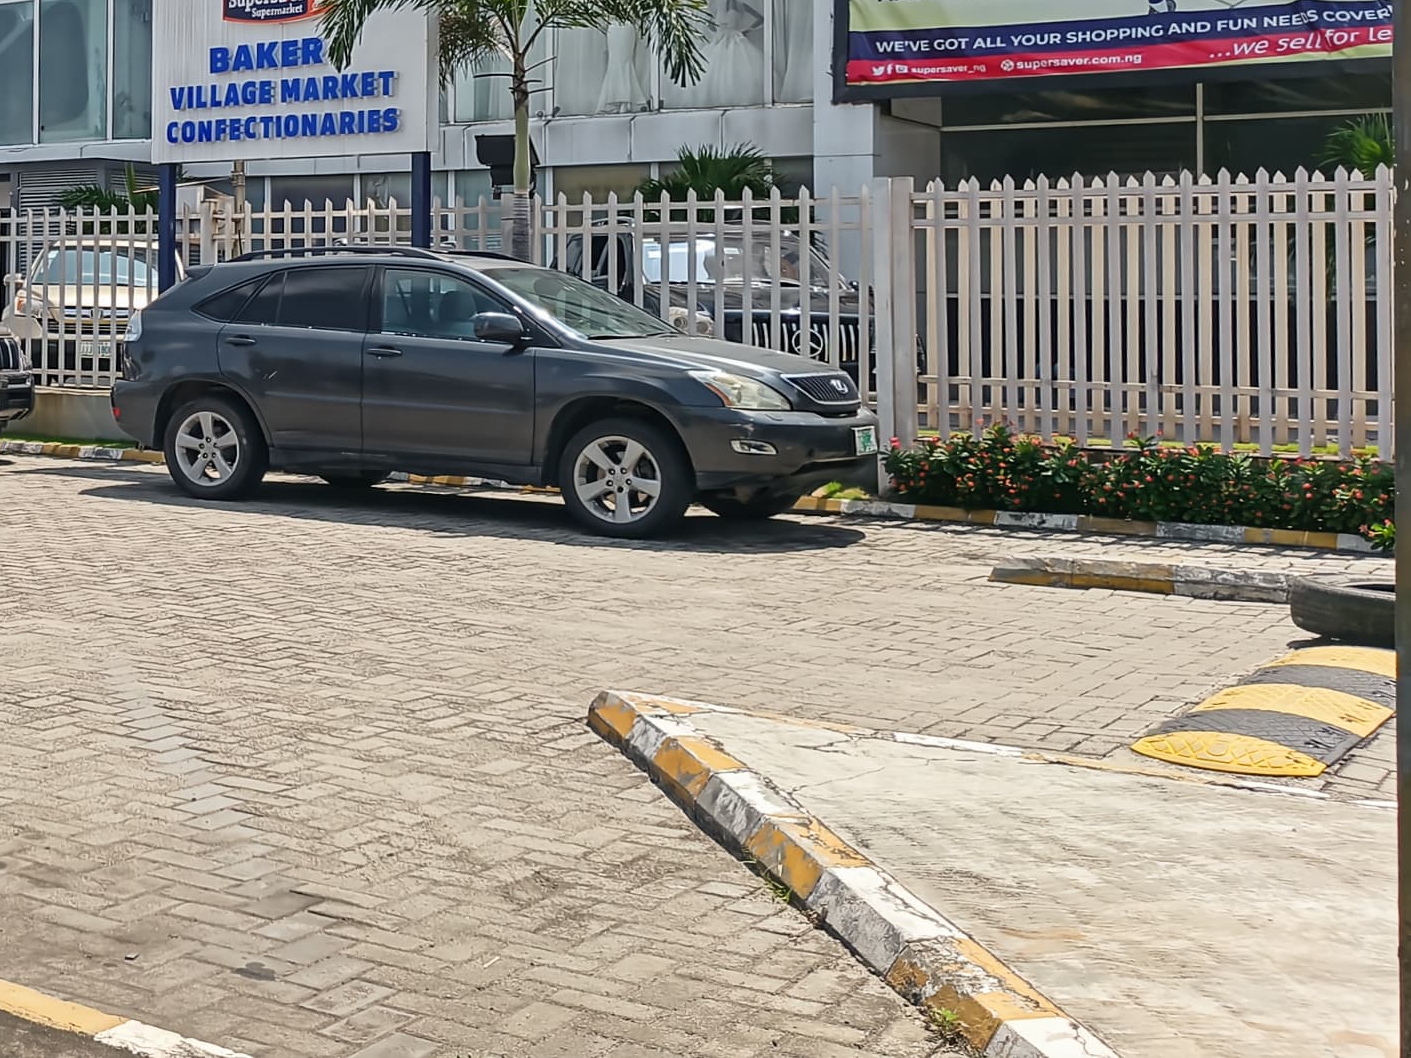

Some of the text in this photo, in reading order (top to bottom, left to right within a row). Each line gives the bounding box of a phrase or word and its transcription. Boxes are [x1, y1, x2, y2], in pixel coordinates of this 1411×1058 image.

[251, 4, 303, 19] Supermarket
[876, 40, 929, 53] WE'VE
[933, 38, 969, 51] GOT
[973, 37, 1006, 49] ALL
[1011, 33, 1061, 47] YOUR
[1066, 25, 1163, 44] SHOPPING
[1168, 21, 1211, 36] AND
[1216, 18, 1257, 32] FUN
[1277, 31, 1321, 52] sell
[1326, 27, 1359, 47] for
[1016, 53, 1142, 71] supersaver.com.ng
[170, 71, 396, 110] VILLAGE MARKET
[166, 108, 399, 144] CONFECTIONARIES
